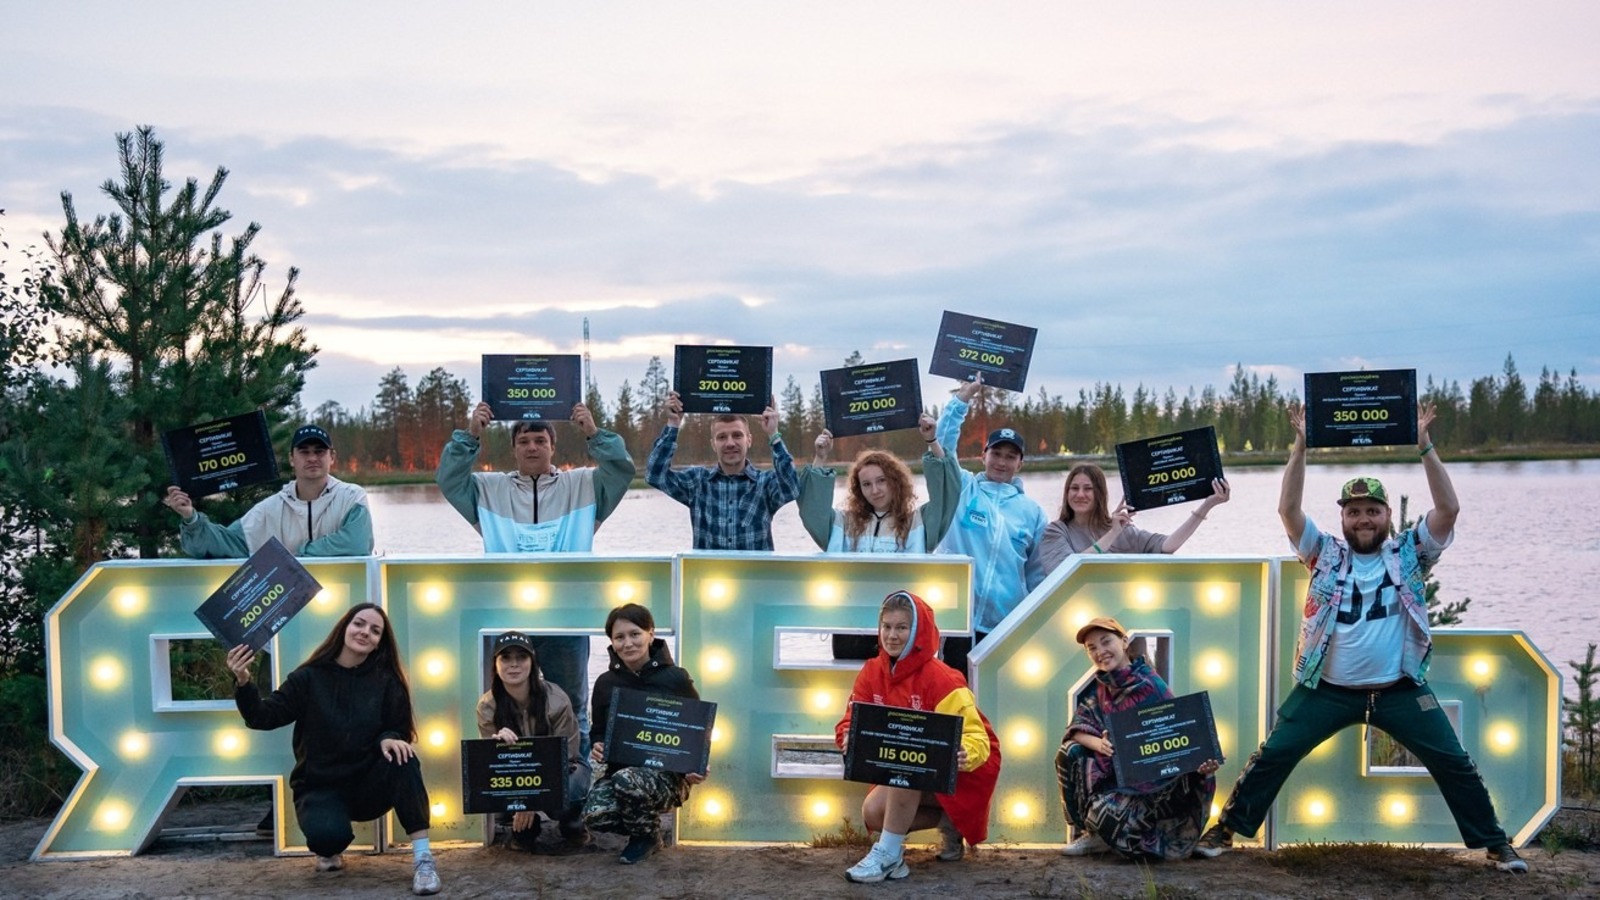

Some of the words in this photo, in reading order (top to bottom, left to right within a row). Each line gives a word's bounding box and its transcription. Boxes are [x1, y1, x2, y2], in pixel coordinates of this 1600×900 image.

[972, 329, 1003, 339] СЕРТИФИКАТ
[959, 349, 979, 360] 372
[981, 353, 1004, 365] 000
[699, 381, 719, 390] 370
[723, 381, 746, 391] 000
[854, 377, 886, 385] СЕРТИФИКАТ
[507, 389, 528, 398] 350
[532, 389, 556, 398] 000
[849, 401, 869, 412] 270
[873, 398, 896, 409] 000
[1333, 411, 1357, 422] 350
[1362, 410, 1388, 421] 000
[199, 432, 232, 443] СЕРТИФИКАТ
[1151, 446, 1183, 457] СЕРТИФИКАТ
[199, 459, 218, 472] 170
[221, 453, 246, 467] 000
[1148, 473, 1168, 485] 270
[1172, 467, 1196, 480] 000
[231, 573, 259, 600] СЕРТИФИКАТ
[240, 605, 262, 628] 200
[262, 584, 284, 606] 000
[645, 707, 679, 717] СЕРТИФИКАТ
[1141, 714, 1175, 726] СЕРТИФИКАТ
[888, 723, 924, 733] СЕРТИФИКАТ
[636, 730, 652, 741] 45
[655, 733, 680, 746] 000
[1140, 742, 1160, 756] 180
[1163, 736, 1189, 750] 000
[879, 747, 896, 760] 115
[900, 751, 927, 763] 000
[490, 777, 512, 788] 335
[516, 776, 541, 787] 000
